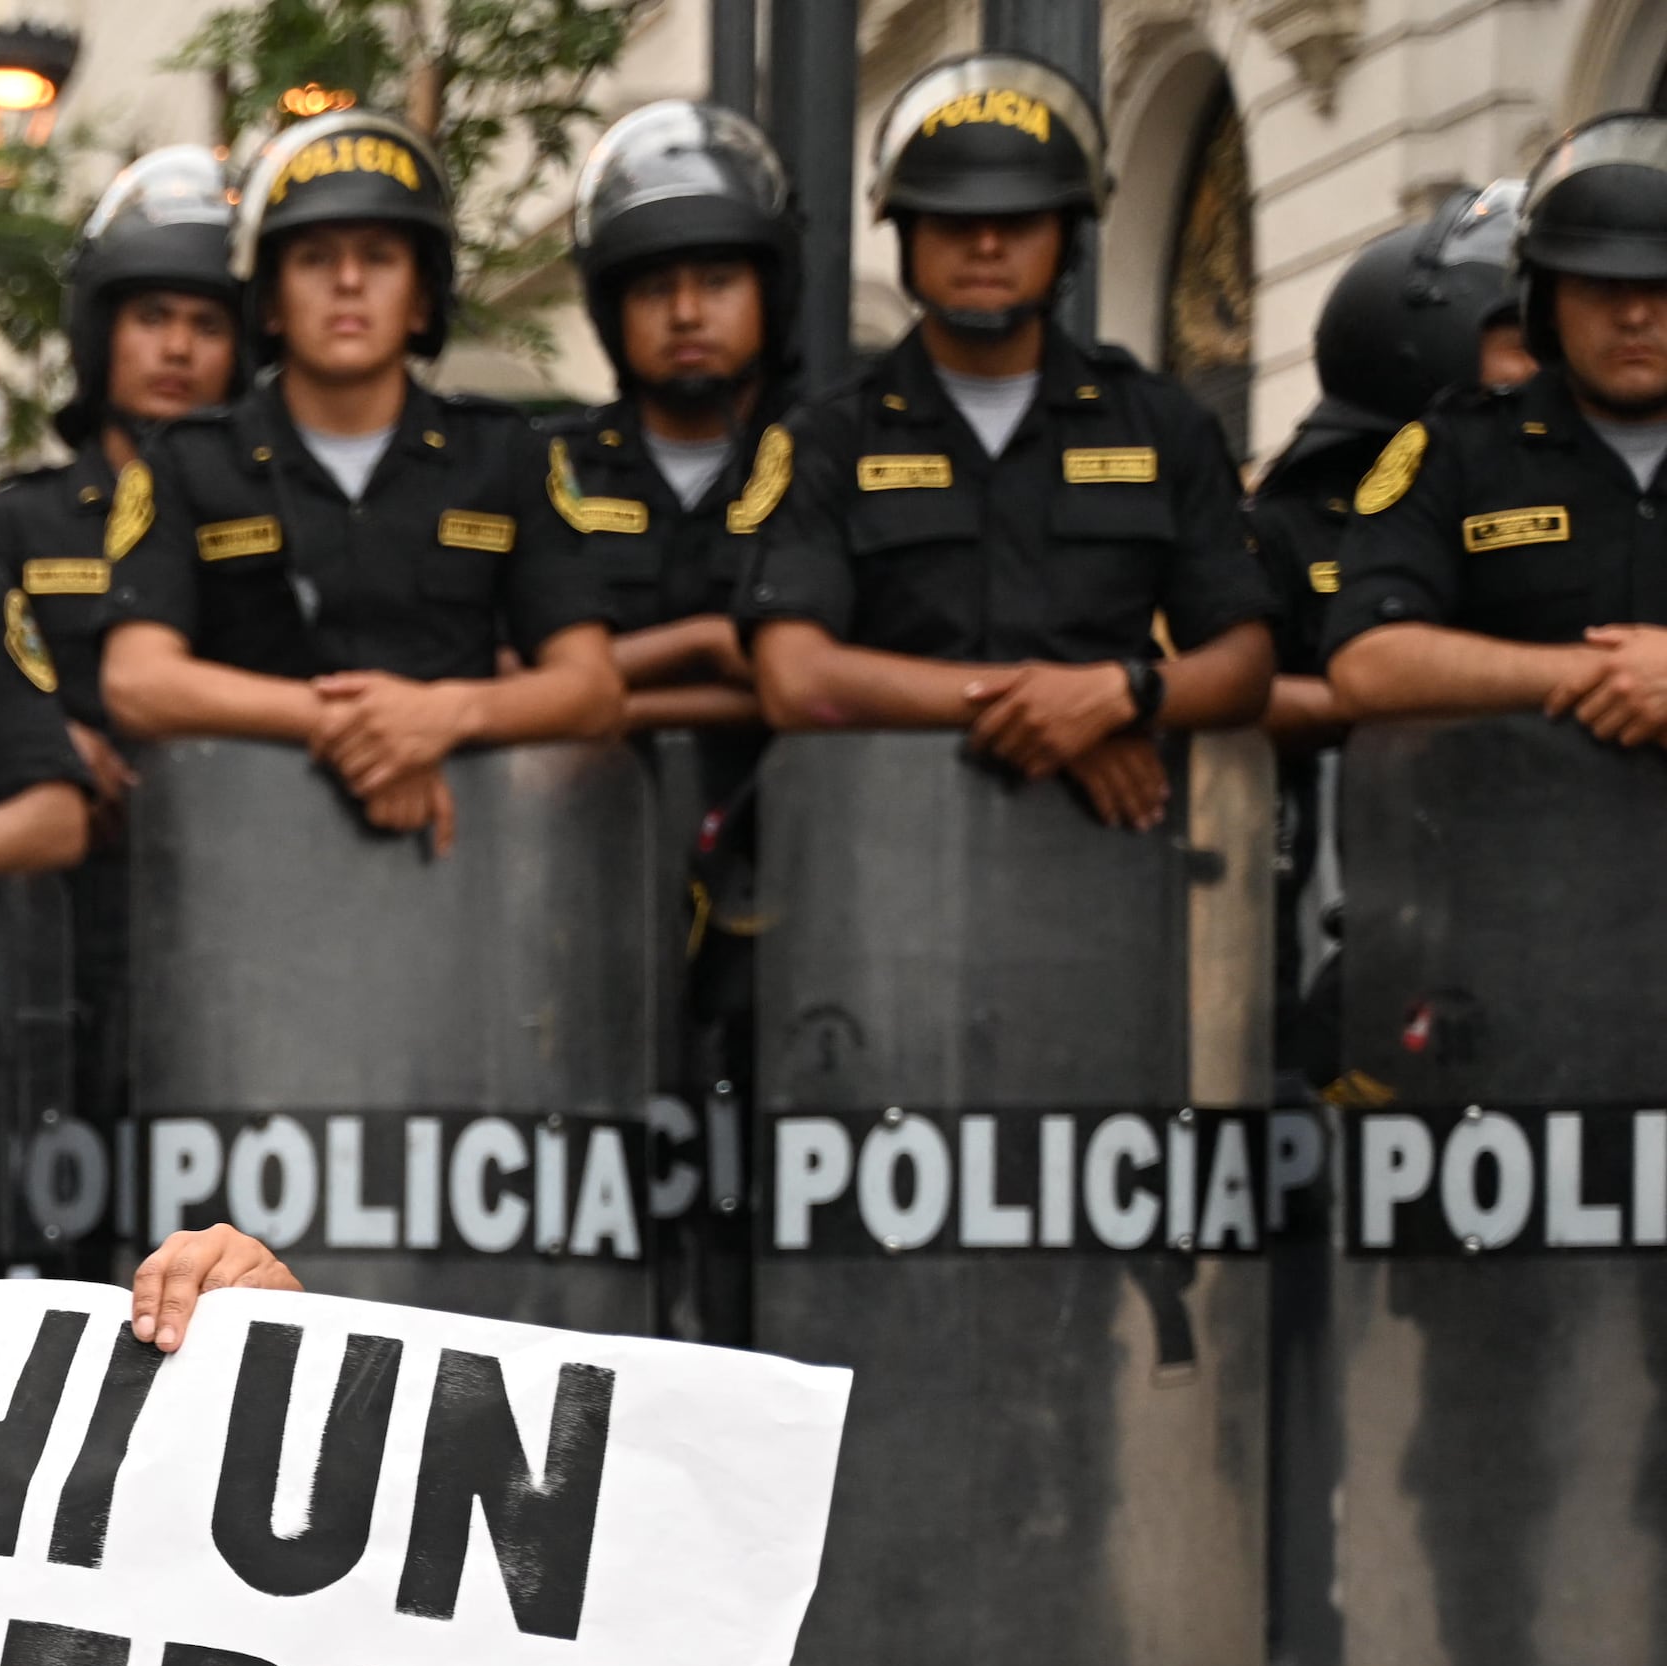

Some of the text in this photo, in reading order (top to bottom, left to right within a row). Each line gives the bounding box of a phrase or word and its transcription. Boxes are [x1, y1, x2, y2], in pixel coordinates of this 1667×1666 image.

[148, 1113, 641, 1260] POLICIA
[774, 1113, 1259, 1251] POLICIA
[210, 1321, 615, 1641] UN
